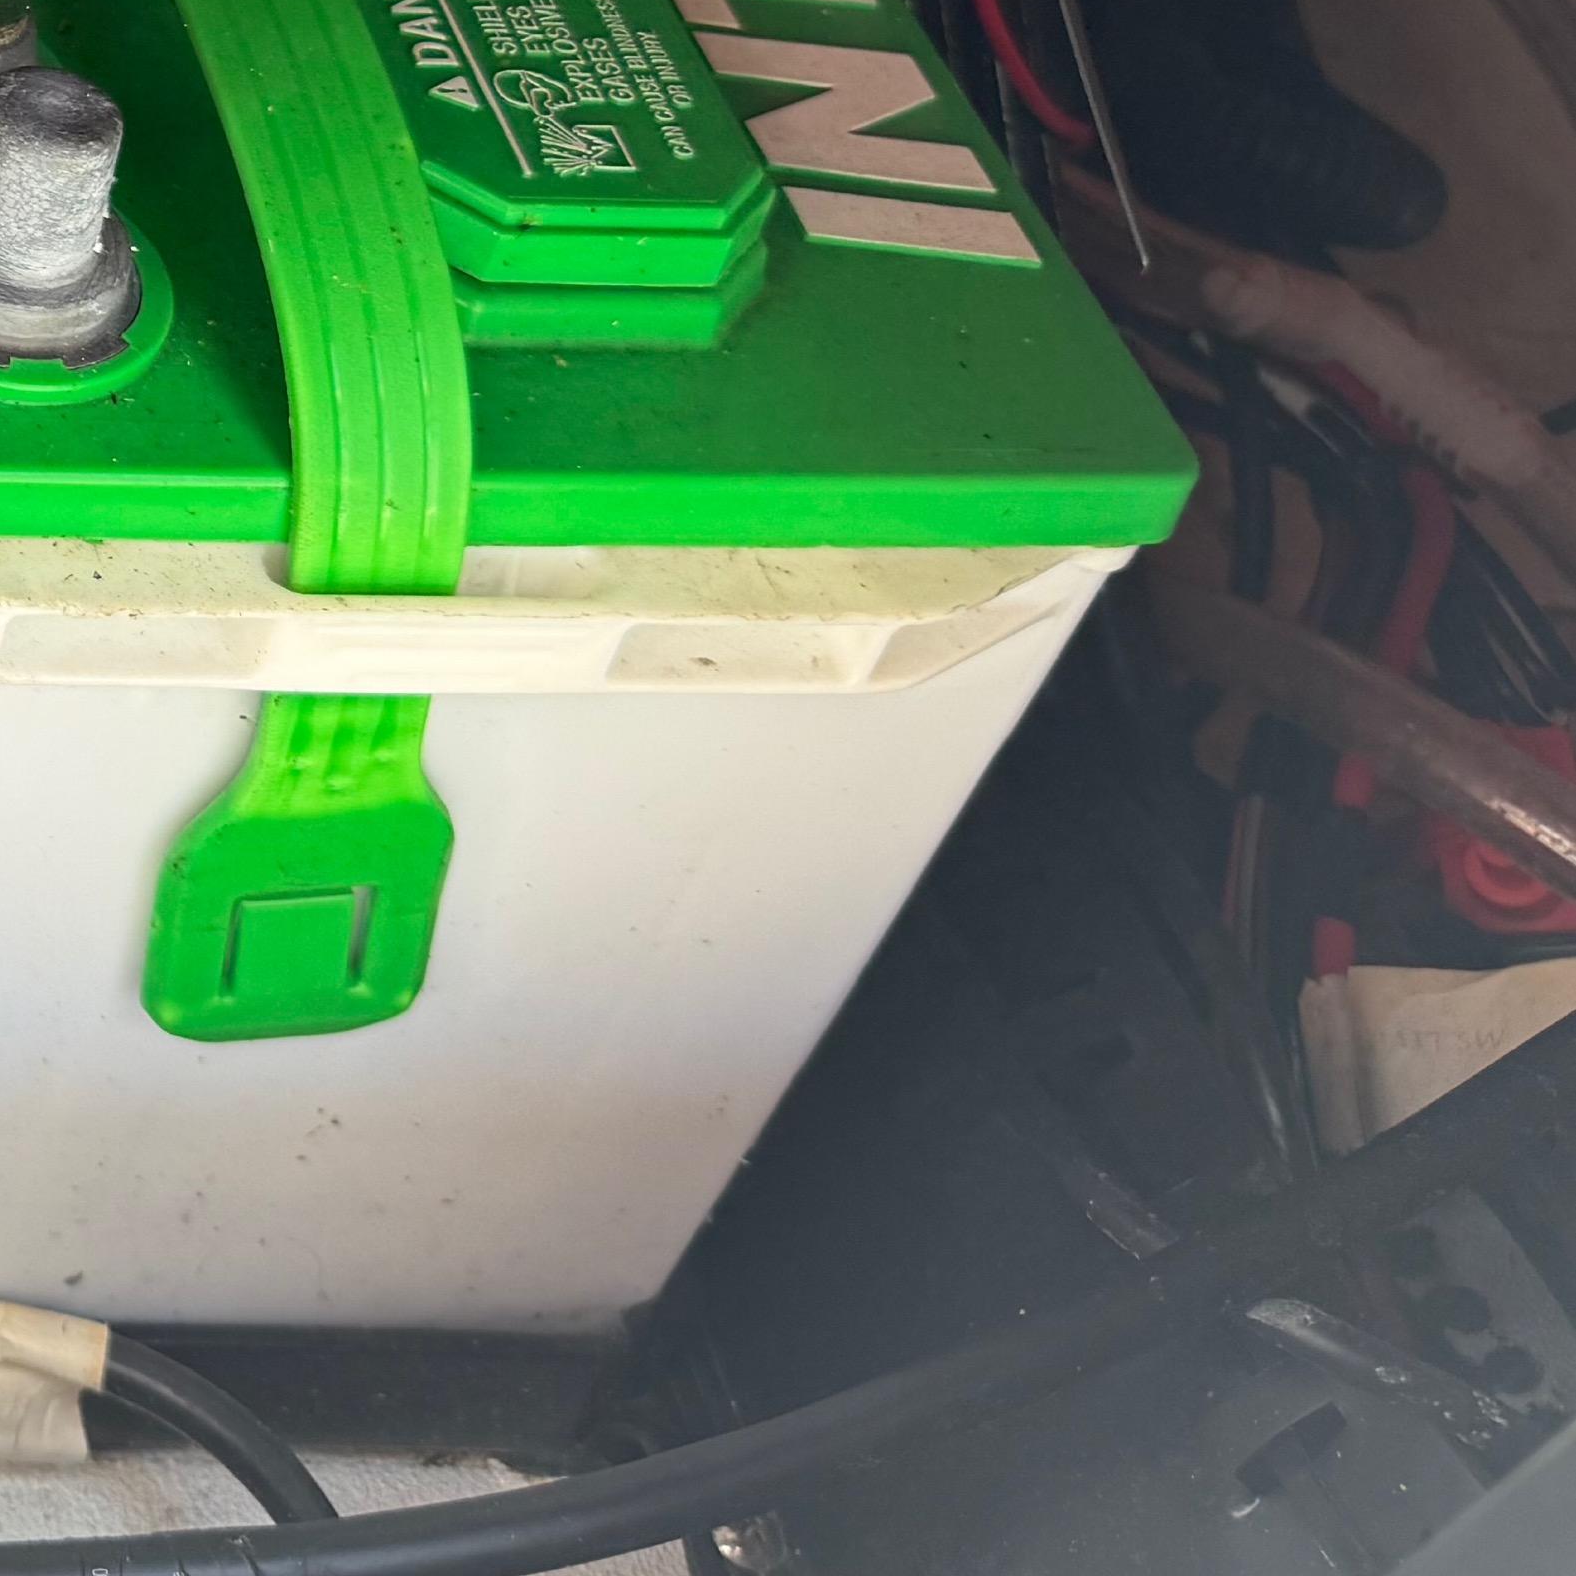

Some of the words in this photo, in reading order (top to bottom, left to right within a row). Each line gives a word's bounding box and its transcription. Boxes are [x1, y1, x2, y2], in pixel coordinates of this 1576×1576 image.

[506, 5, 550, 54] EYES
[530, 0, 604, 102] EXPLOSIVE
[582, 37, 635, 102] GASES
[637, 31, 679, 80] INJURY
[634, 74, 675, 121] CAUSE
[666, 83, 691, 105] OR
[661, 124, 694, 157] CAN
